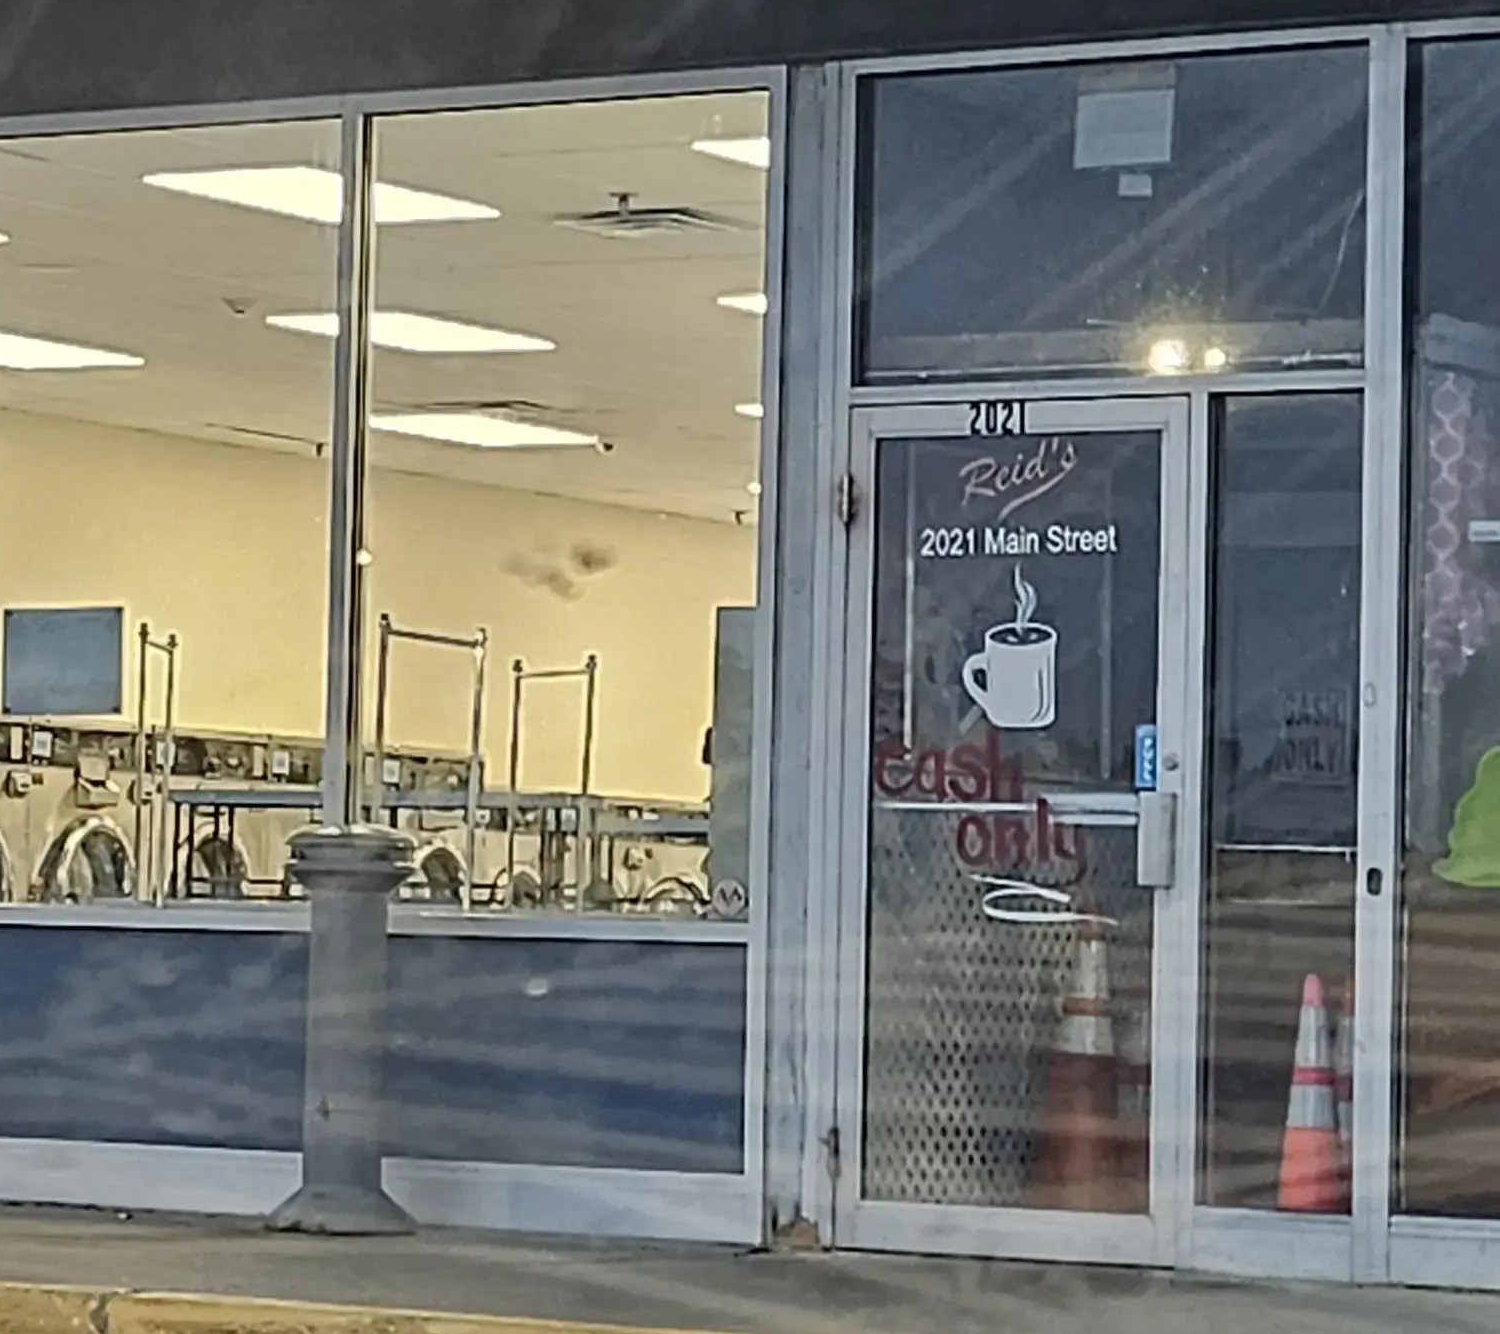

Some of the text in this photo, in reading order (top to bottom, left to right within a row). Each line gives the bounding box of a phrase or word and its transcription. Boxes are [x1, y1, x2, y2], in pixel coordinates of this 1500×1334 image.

[968, 402, 1027, 435] 2021
[958, 436, 1079, 520] Reid's
[920, 525, 1118, 557] 2021 Main Street
[956, 797, 1088, 886] only
